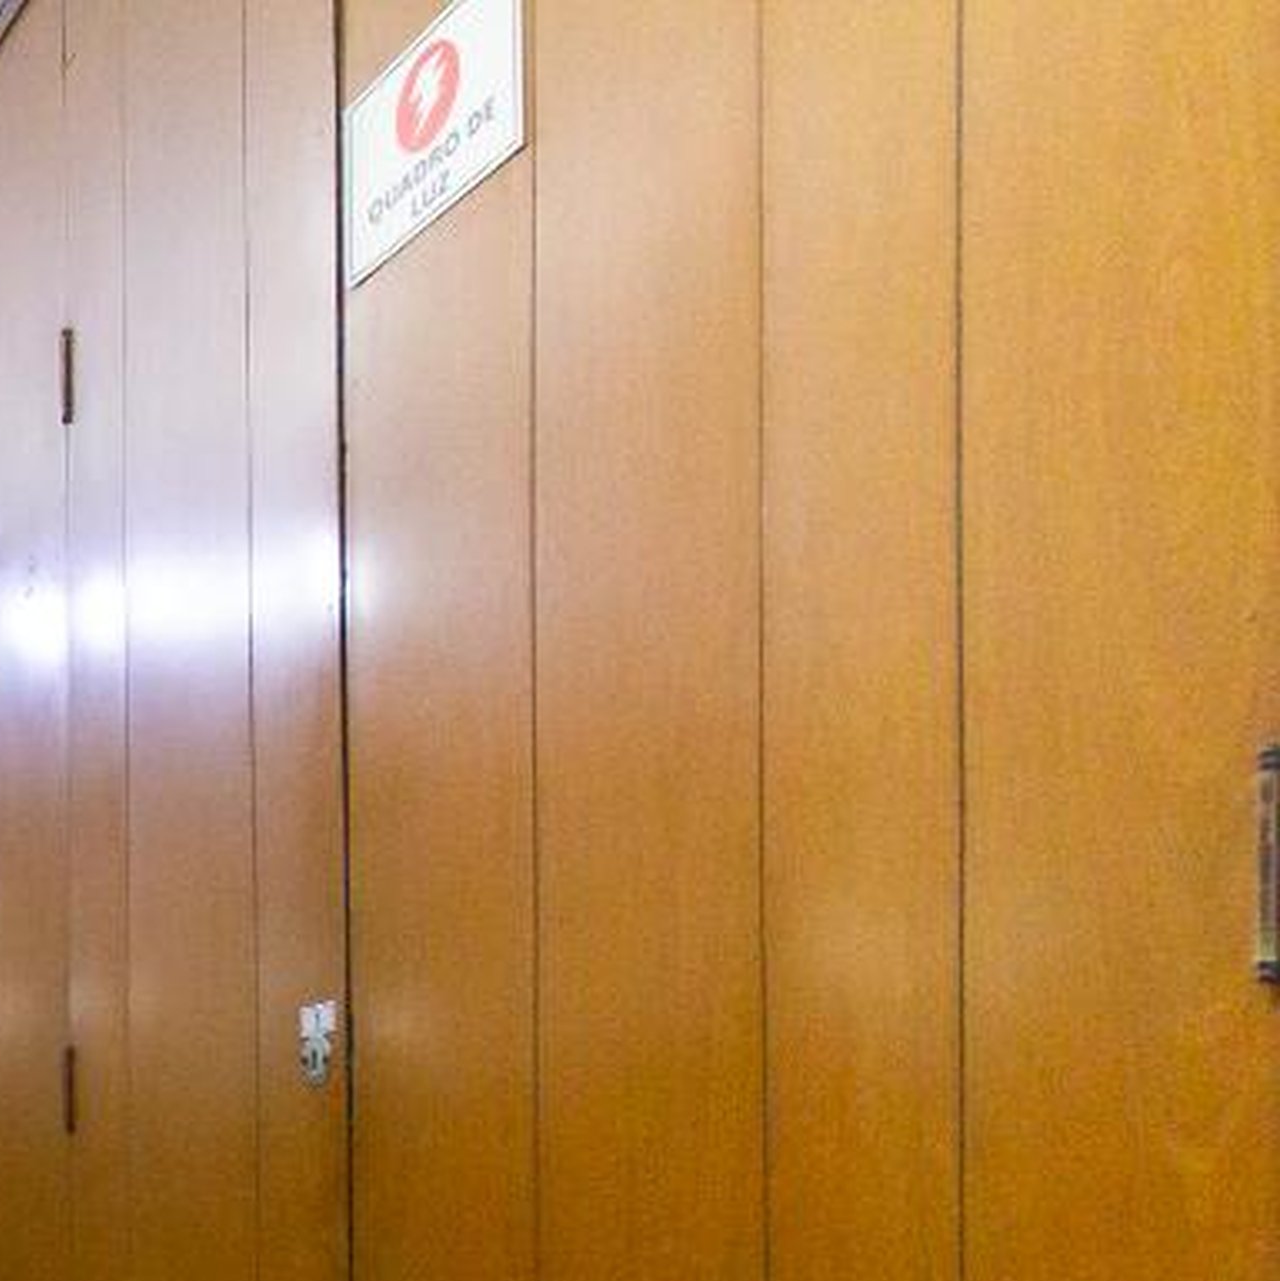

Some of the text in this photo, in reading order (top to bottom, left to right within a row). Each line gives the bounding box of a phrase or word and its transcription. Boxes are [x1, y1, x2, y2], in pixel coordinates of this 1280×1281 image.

[367, 96, 495, 224] QUADRO DE
[411, 170, 450, 217] LUZ
